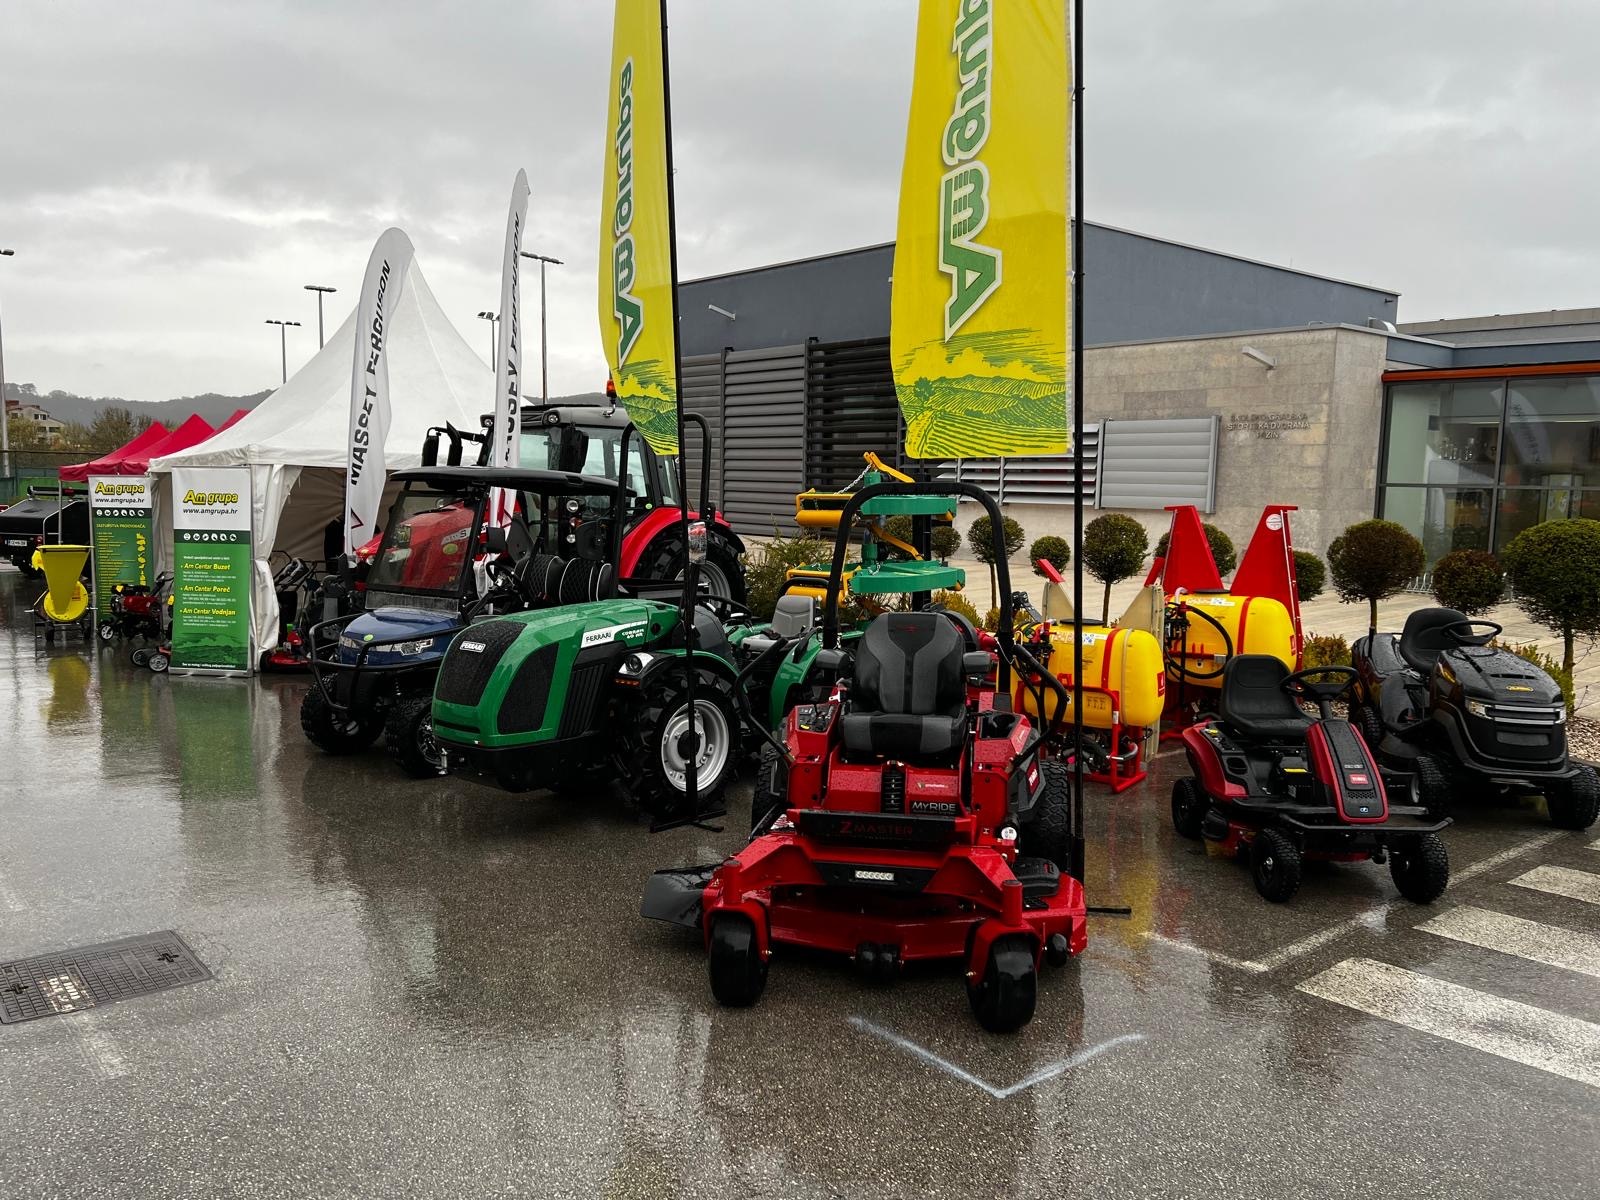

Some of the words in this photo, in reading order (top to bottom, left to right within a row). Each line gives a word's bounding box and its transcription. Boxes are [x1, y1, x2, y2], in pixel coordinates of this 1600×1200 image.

[504, 359, 518, 462] SSEY
[95, 481, 115, 495] Am
[116, 485, 145, 496] grupa
[183, 490, 206, 505] Am
[207, 493, 238, 505] grupa
[211, 608, 236, 616] Vodnjan
[585, 632, 611, 642] FERRARI
